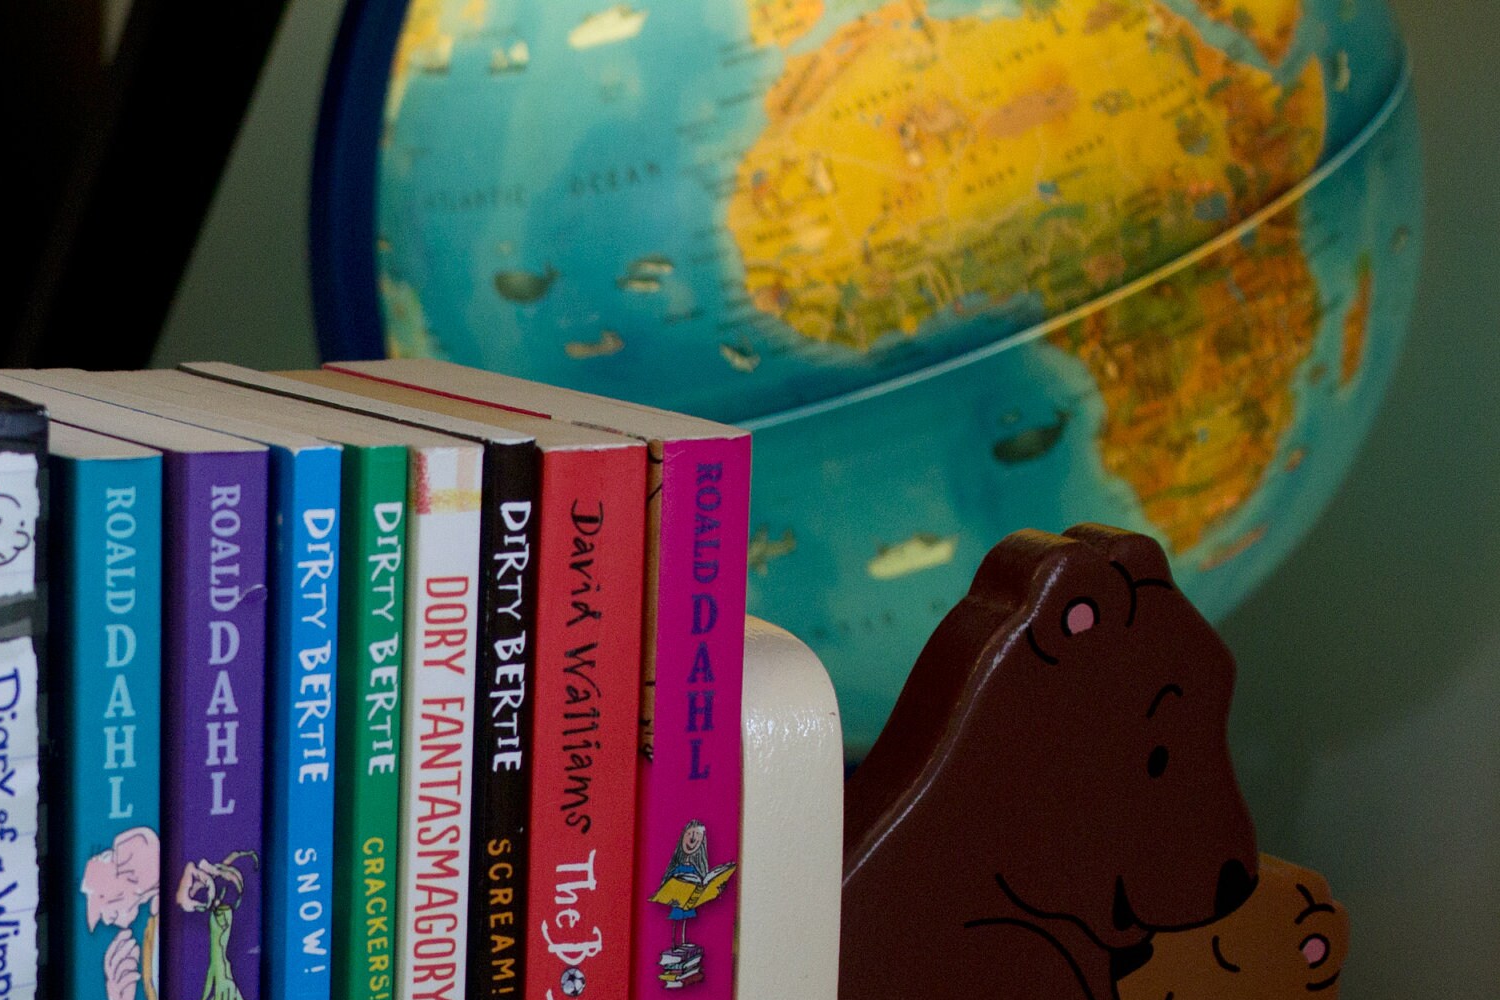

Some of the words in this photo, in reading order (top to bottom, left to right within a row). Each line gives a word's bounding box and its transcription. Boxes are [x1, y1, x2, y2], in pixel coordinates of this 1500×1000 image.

[105, 486, 137, 614] ROALD
[209, 484, 241, 612] ROALD
[297, 508, 336, 629] DIRTY
[368, 502, 403, 622] DIRTY
[493, 501, 532, 621] DIRTY
[568, 498, 604, 627] David
[692, 461, 724, 585] ROALD
[422, 576, 469, 675] DORY
[686, 593, 719, 781] DAHL
[104, 623, 137, 819] DAHL
[206, 620, 240, 816] DAHL
[295, 640, 331, 784] BERTIE
[365, 632, 398, 776] BERTIE
[489, 630, 526, 773] BERTIE
[560, 641, 602, 835] Walliams
[294, 848, 327, 974] SNOW!
[362, 837, 390, 1000] CRACKERS!
[487, 838, 515, 995] SCREAM!
[554, 849, 597, 928] The
